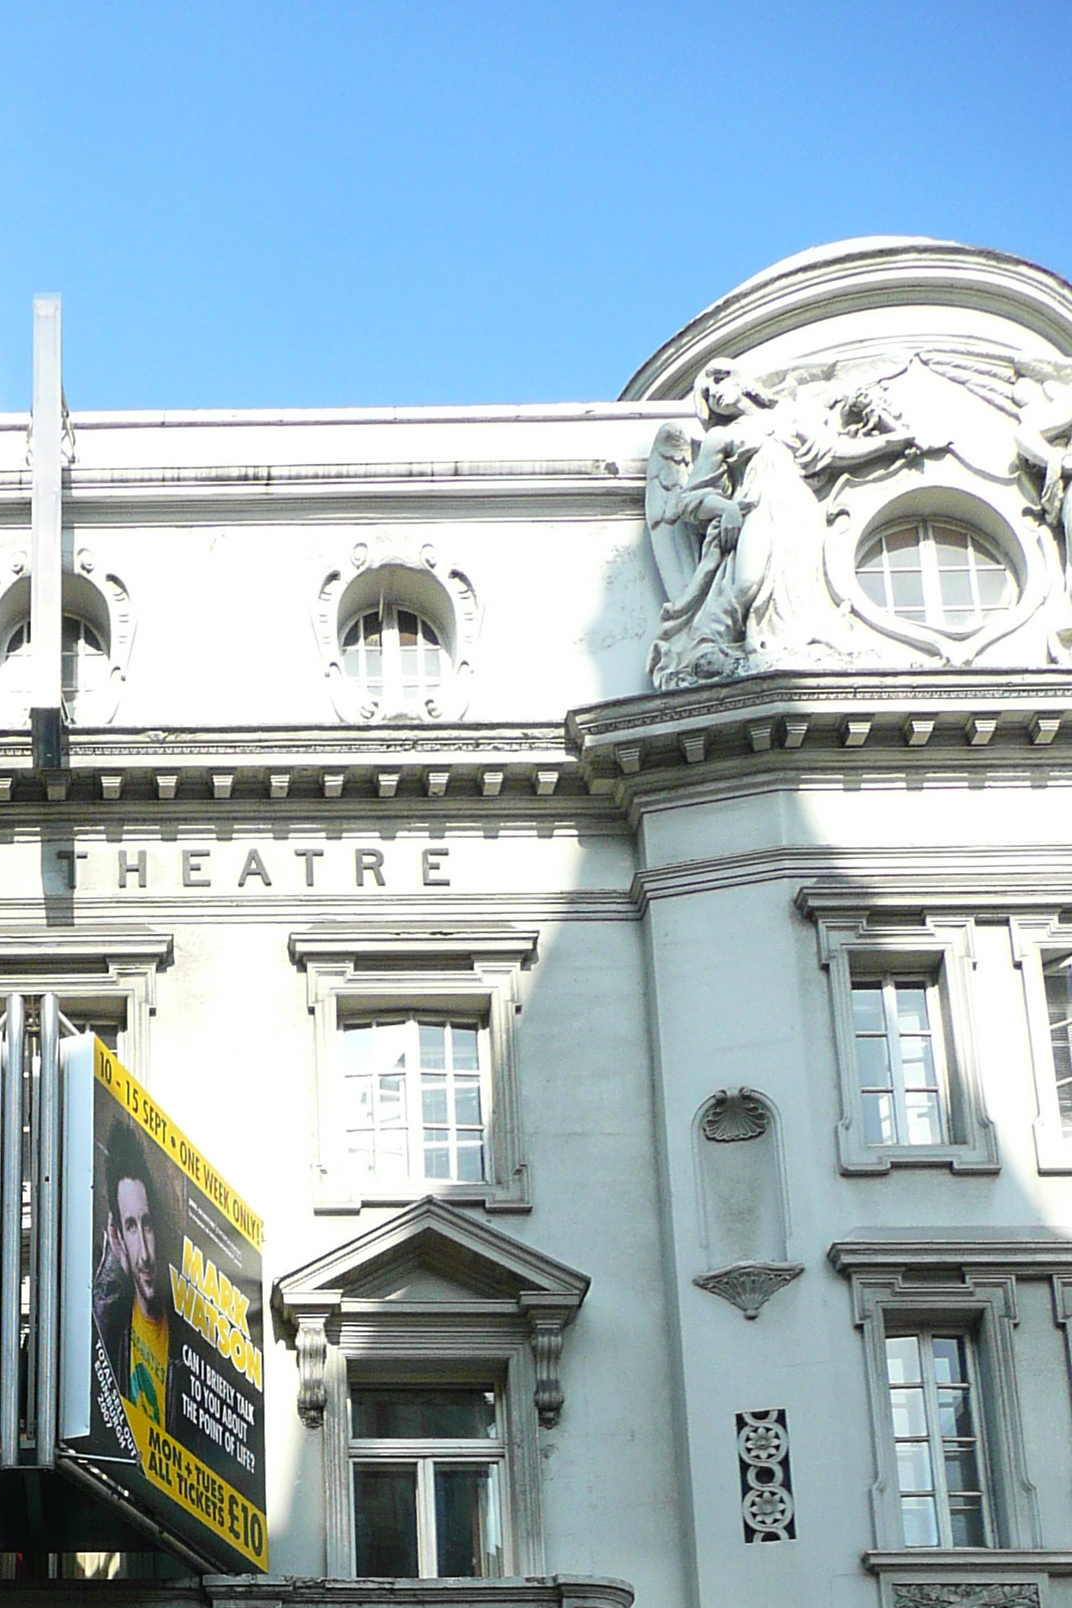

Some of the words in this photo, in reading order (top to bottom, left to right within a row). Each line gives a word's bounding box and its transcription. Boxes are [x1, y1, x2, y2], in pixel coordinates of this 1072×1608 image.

[56, 847, 452, 890] THEATRE
[100, 1051, 112, 1085] 10
[126, 1080, 138, 1114] 15
[143, 1100, 167, 1144] SEPT
[179, 1141, 200, 1181] ONE
[203, 1164, 229, 1214] WEEK
[232, 1199, 260, 1246] ONLY!
[169, 1262, 262, 1393] WATSON
[181, 1235, 250, 1340] MARK
[94, 1361, 126, 1449] EDINBURGH
[95, 1339, 113, 1391] TOTAL
[110, 1388, 125, 1426] SELL
[122, 1423, 137, 1457] OUT
[96, 1396, 113, 1428] 2007
[182, 1344, 199, 1373] CAN
[200, 1359, 205, 1377] I
[207, 1364, 235, 1408] BRIEFLY
[236, 1389, 256, 1427] TALK
[190, 1374, 202, 1400] TO
[202, 1385, 221, 1419] YOU
[222, 1400, 248, 1443] ABOUT
[148, 1426, 182, 1470] MON
[195, 1464, 225, 1505] TUES
[181, 1392, 197, 1426] THE
[198, 1408, 223, 1446] POINT
[224, 1431, 235, 1455] OF
[236, 1444, 256, 1475] LIFE?
[148, 1451, 172, 1487] ALL
[176, 1471, 225, 1528] TICKETS
[229, 1493, 264, 1557] £10
